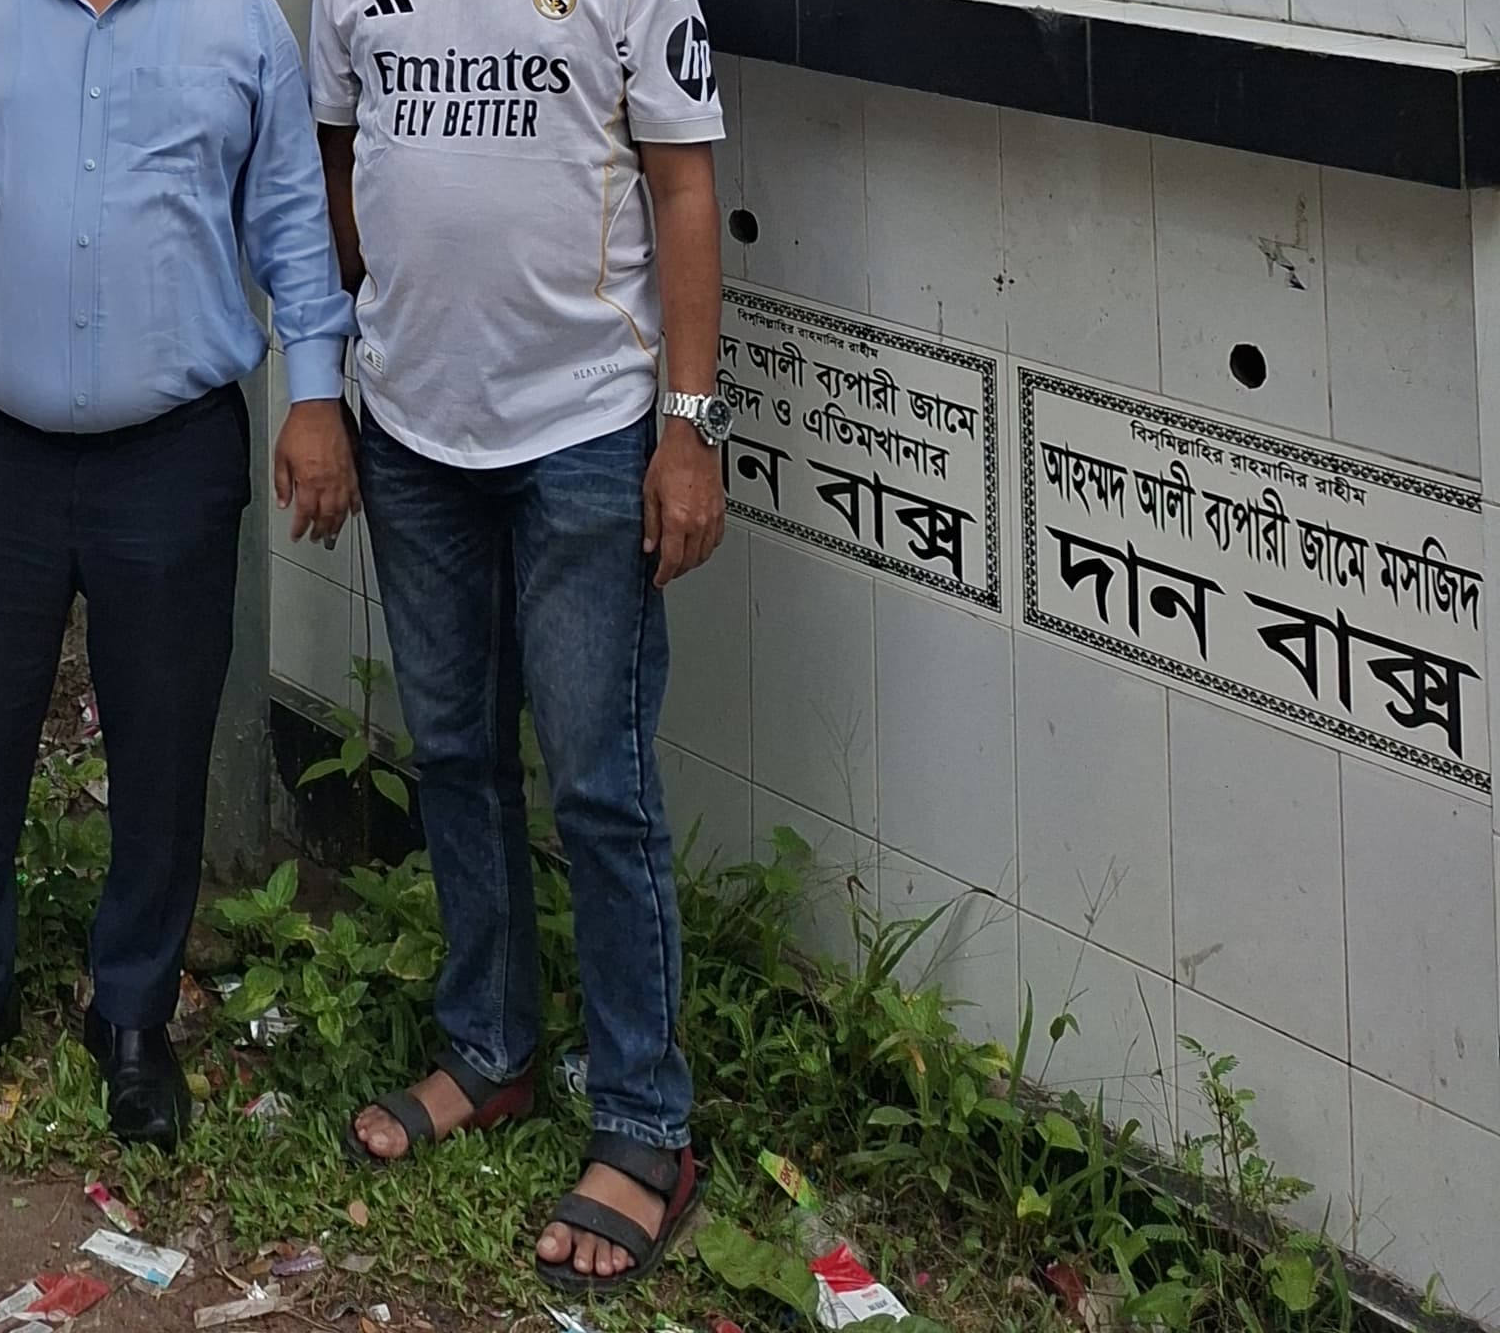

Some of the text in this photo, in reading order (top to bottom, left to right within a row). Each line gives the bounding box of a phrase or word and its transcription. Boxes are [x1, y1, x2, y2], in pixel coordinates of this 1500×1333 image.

[373, 47, 571, 95] Emirates
[679, 16, 712, 103] hp
[394, 99, 538, 137] FLY BETTER
[717, 369, 949, 480] জিদ ও এতিমখানার
[746, 342, 807, 387] আলী
[906, 389, 978, 440] জামে
[721, 433, 976, 583] ান বাক্স
[1313, 475, 1368, 506] রাহীম
[1133, 459, 1197, 541] আলী
[1296, 518, 1370, 596] জামে
[1376, 535, 1484, 632] মসজিদ
[1045, 525, 1483, 757] দান বাক্স
